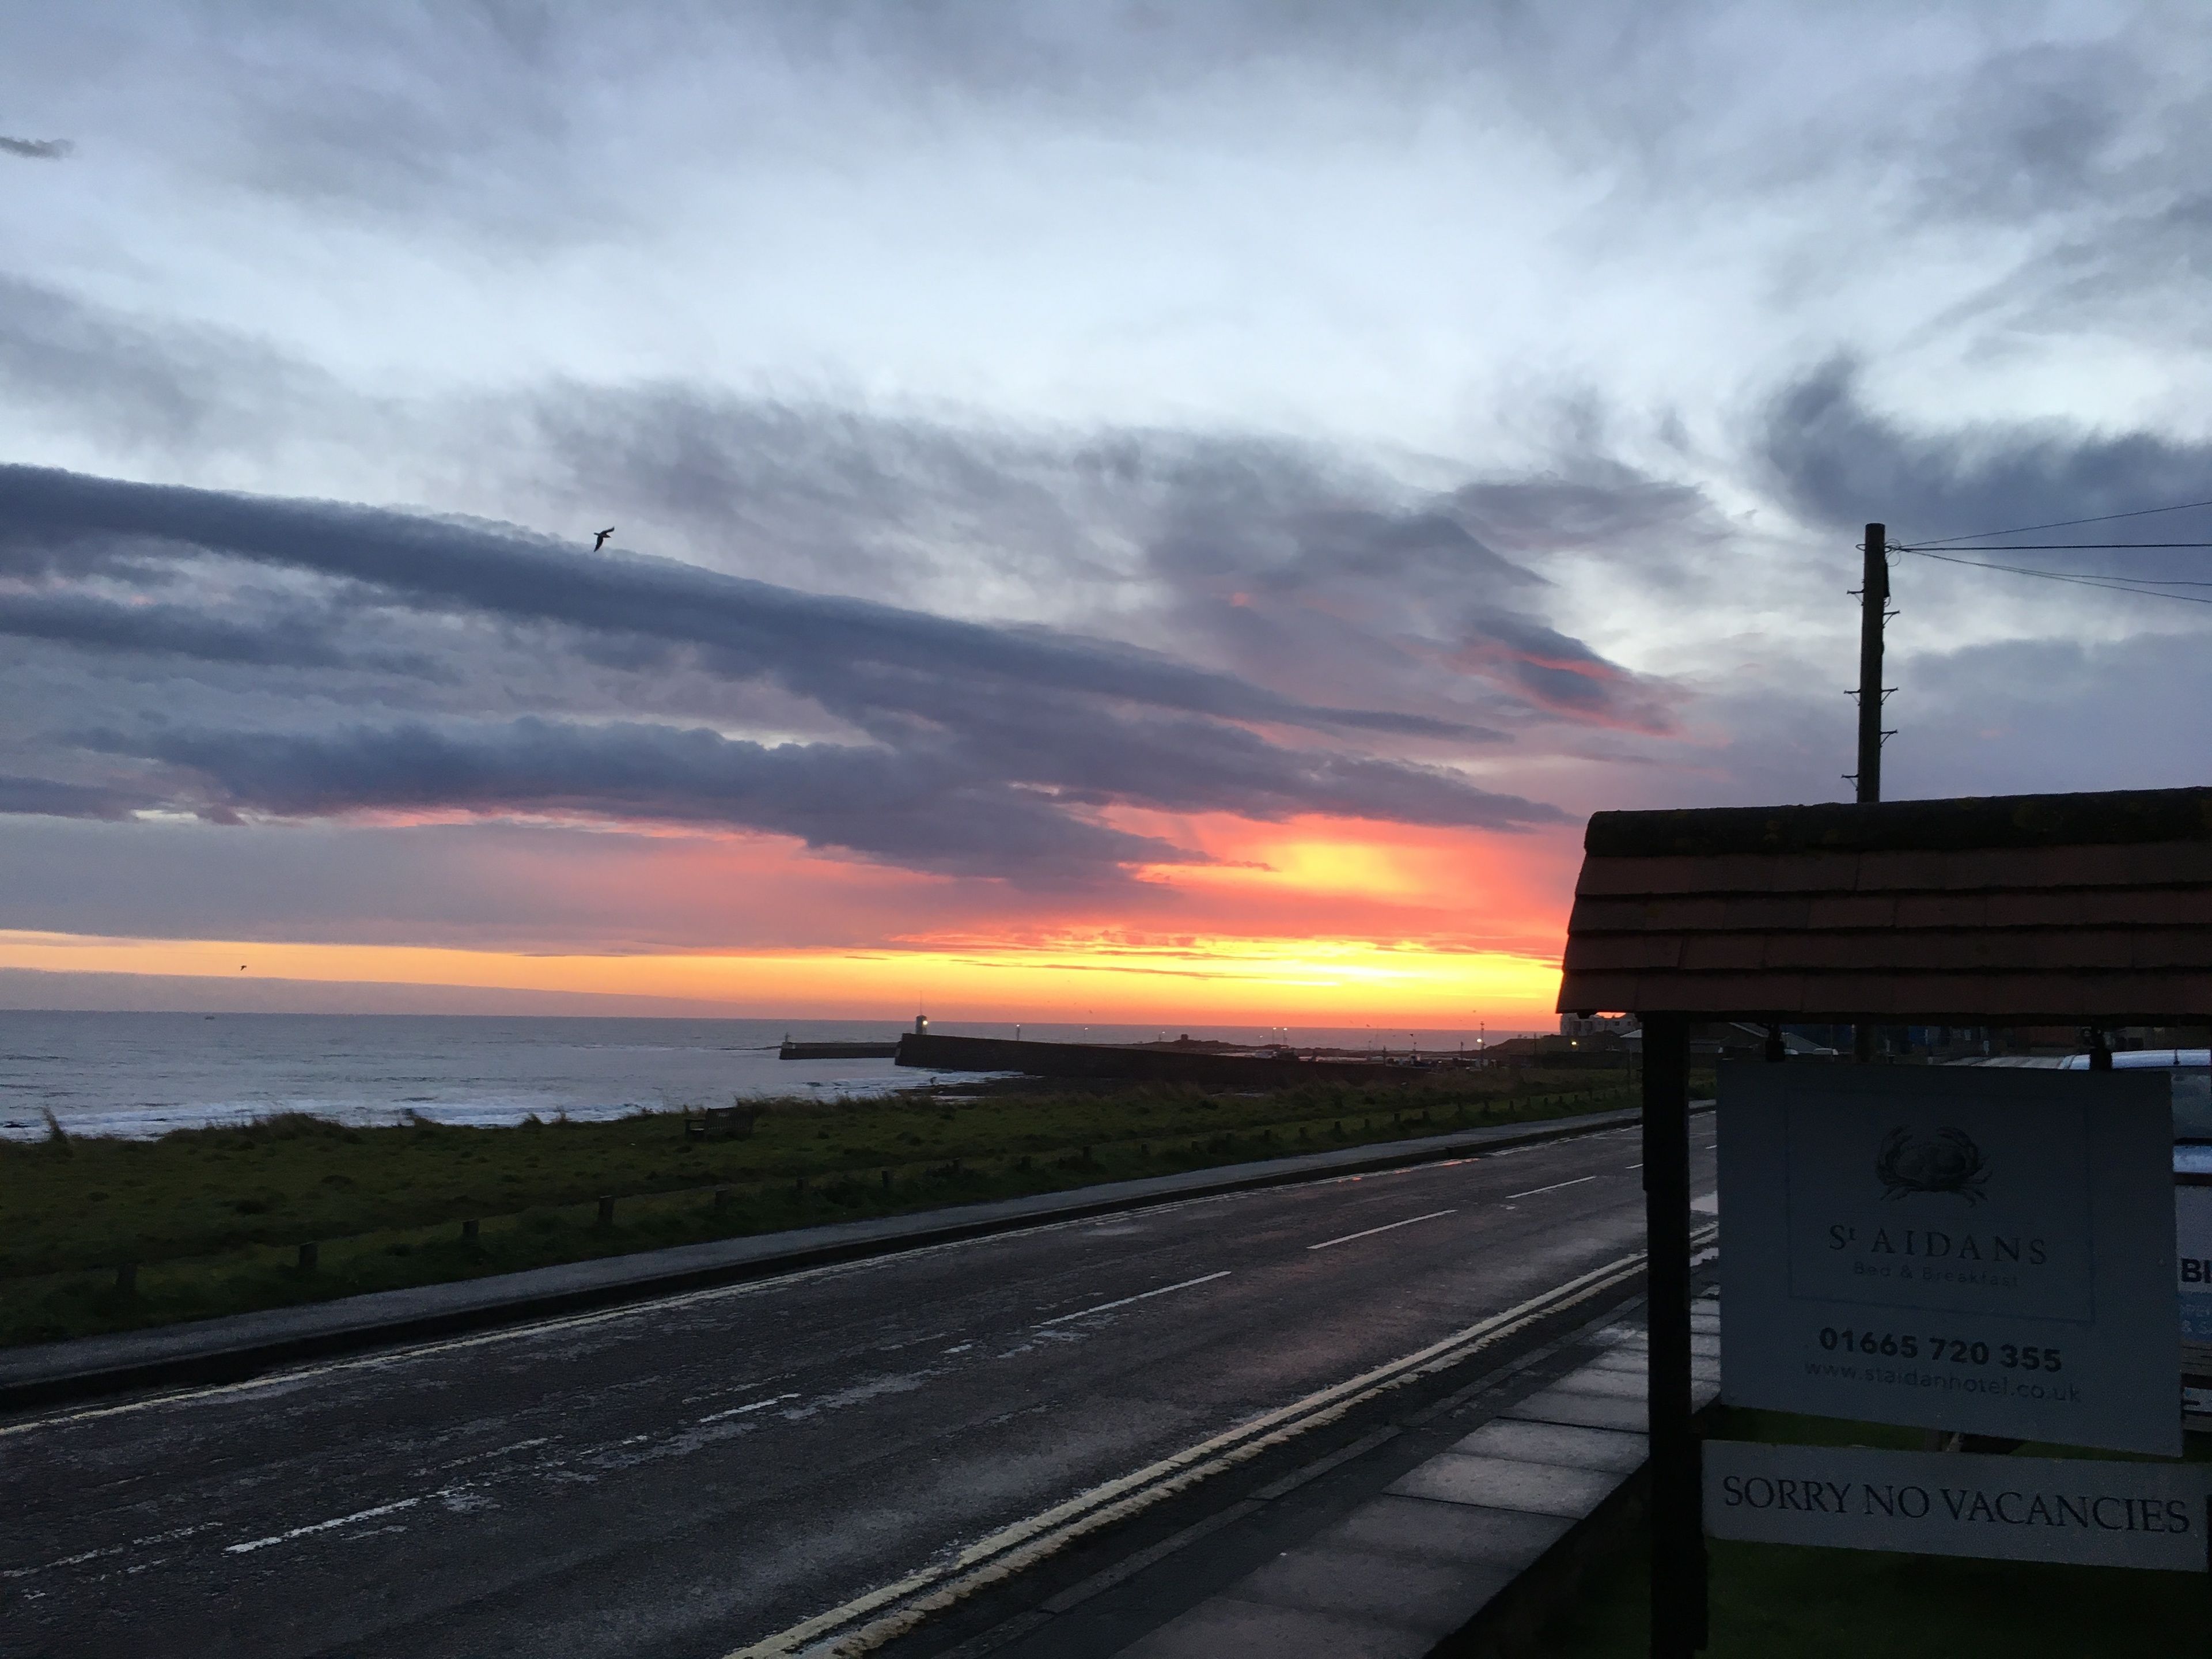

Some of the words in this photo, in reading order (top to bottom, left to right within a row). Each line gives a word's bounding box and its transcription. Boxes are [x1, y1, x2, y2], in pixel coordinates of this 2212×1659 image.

[1829, 1224, 1856, 1251] St
[1872, 1228, 2048, 1265] AIDANS
[1853, 1261, 1891, 1277] Bed
[1900, 1264, 1914, 1279] &
[1922, 1266, 2020, 1287] Breakfast
[1819, 1327, 1919, 1358] 01665
[1929, 1337, 1990, 1365] 720
[1999, 1344, 2062, 1372] 355
[1804, 1362, 2082, 1402] www.staidanhotel.co.uk
[1722, 1475, 1851, 1514] SORRY
[1863, 1484, 1930, 1518] NO
[1940, 1488, 2190, 1535] VACANCIES
